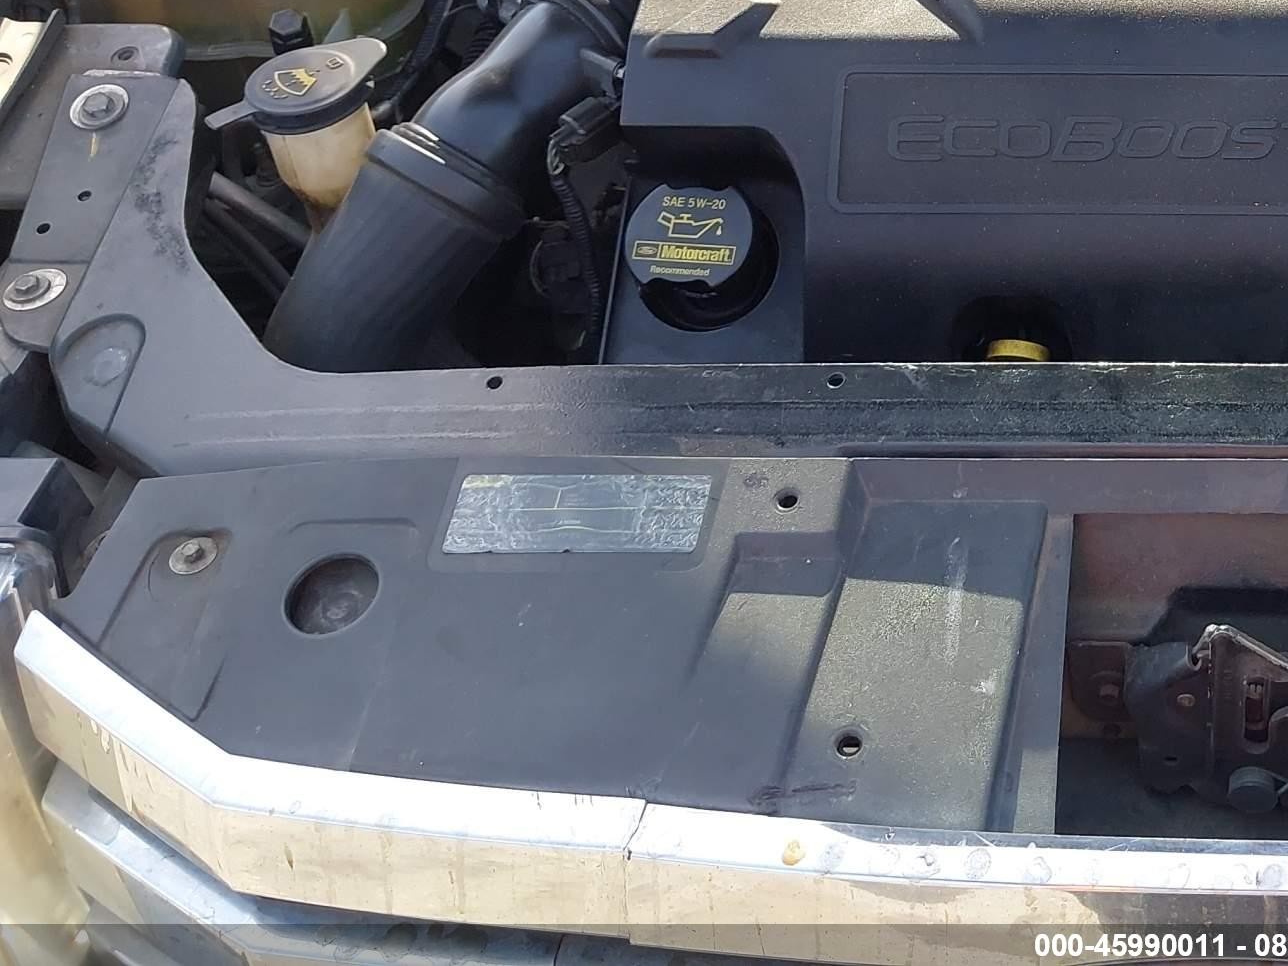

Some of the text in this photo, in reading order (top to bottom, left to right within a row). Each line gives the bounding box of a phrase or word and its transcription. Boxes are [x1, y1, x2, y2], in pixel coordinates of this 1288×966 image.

[662, 196, 727, 210] SAE 5W-20
[661, 245, 730, 262] Motorcraft
[649, 265, 711, 276] Recommended
